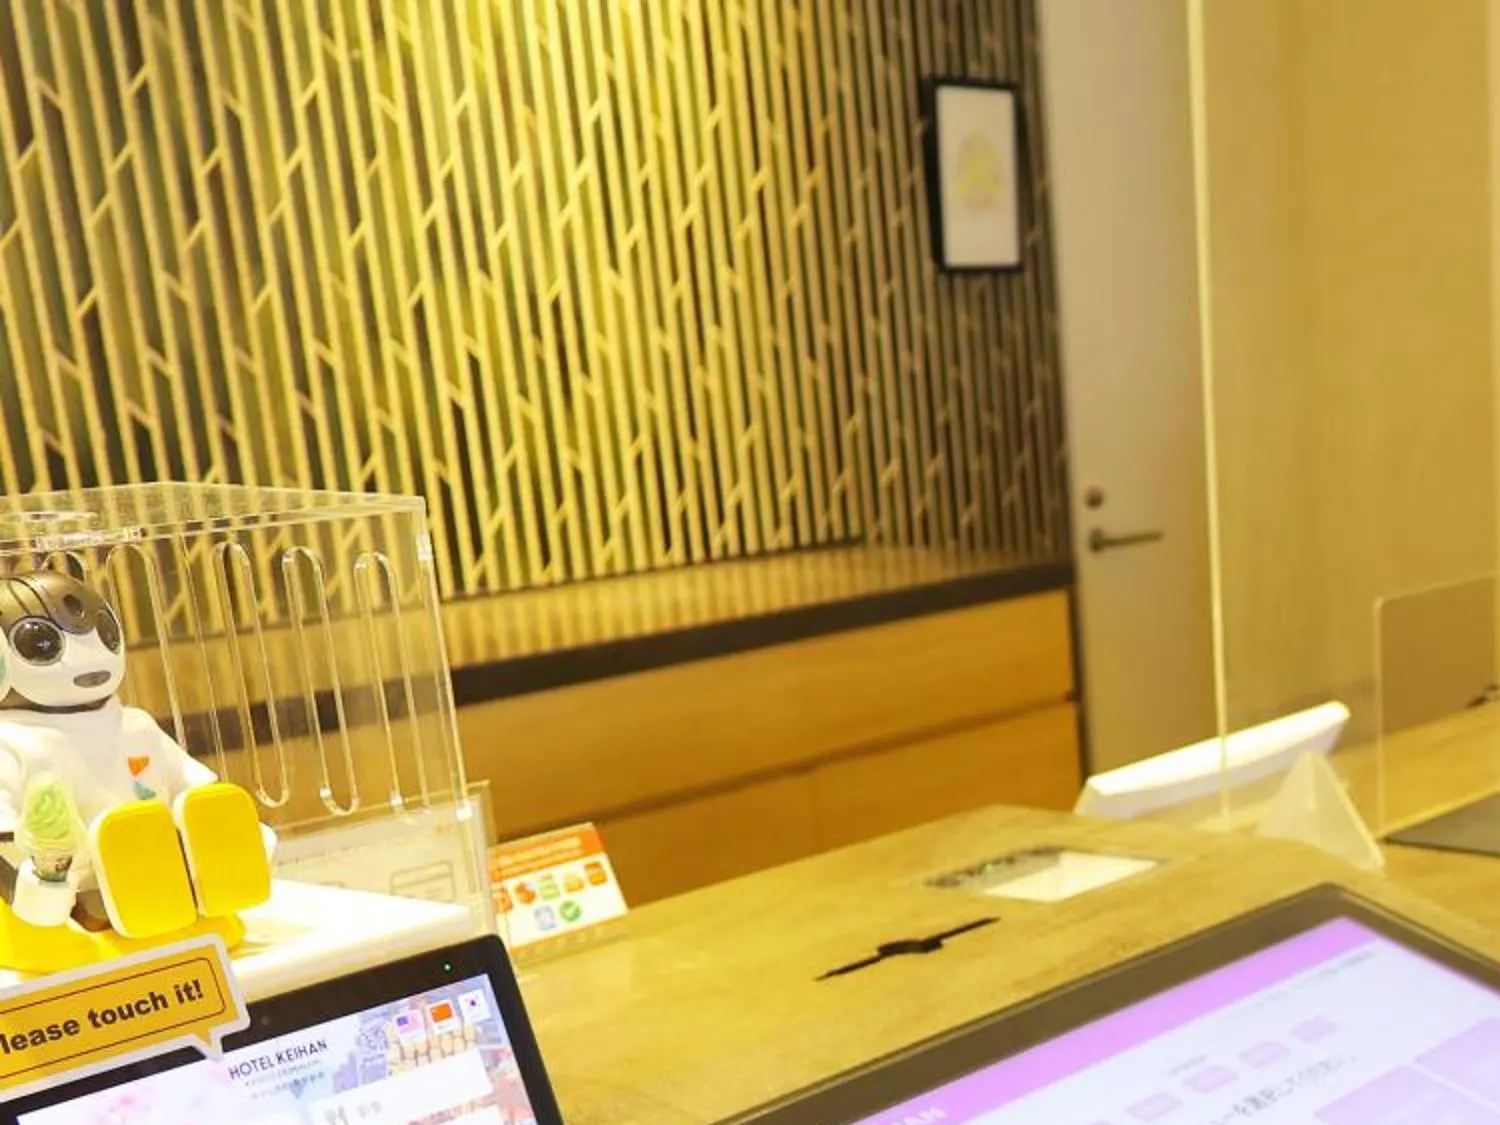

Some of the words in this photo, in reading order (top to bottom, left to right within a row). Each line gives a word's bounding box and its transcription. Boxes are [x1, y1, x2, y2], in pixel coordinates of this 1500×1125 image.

[0, 1019, 80, 1054] lease
[88, 991, 169, 1029] touch
[174, 980, 204, 1005] it!
[228, 1056, 275, 1081] HOTEL
[276, 1037, 328, 1065] KEIHAN
